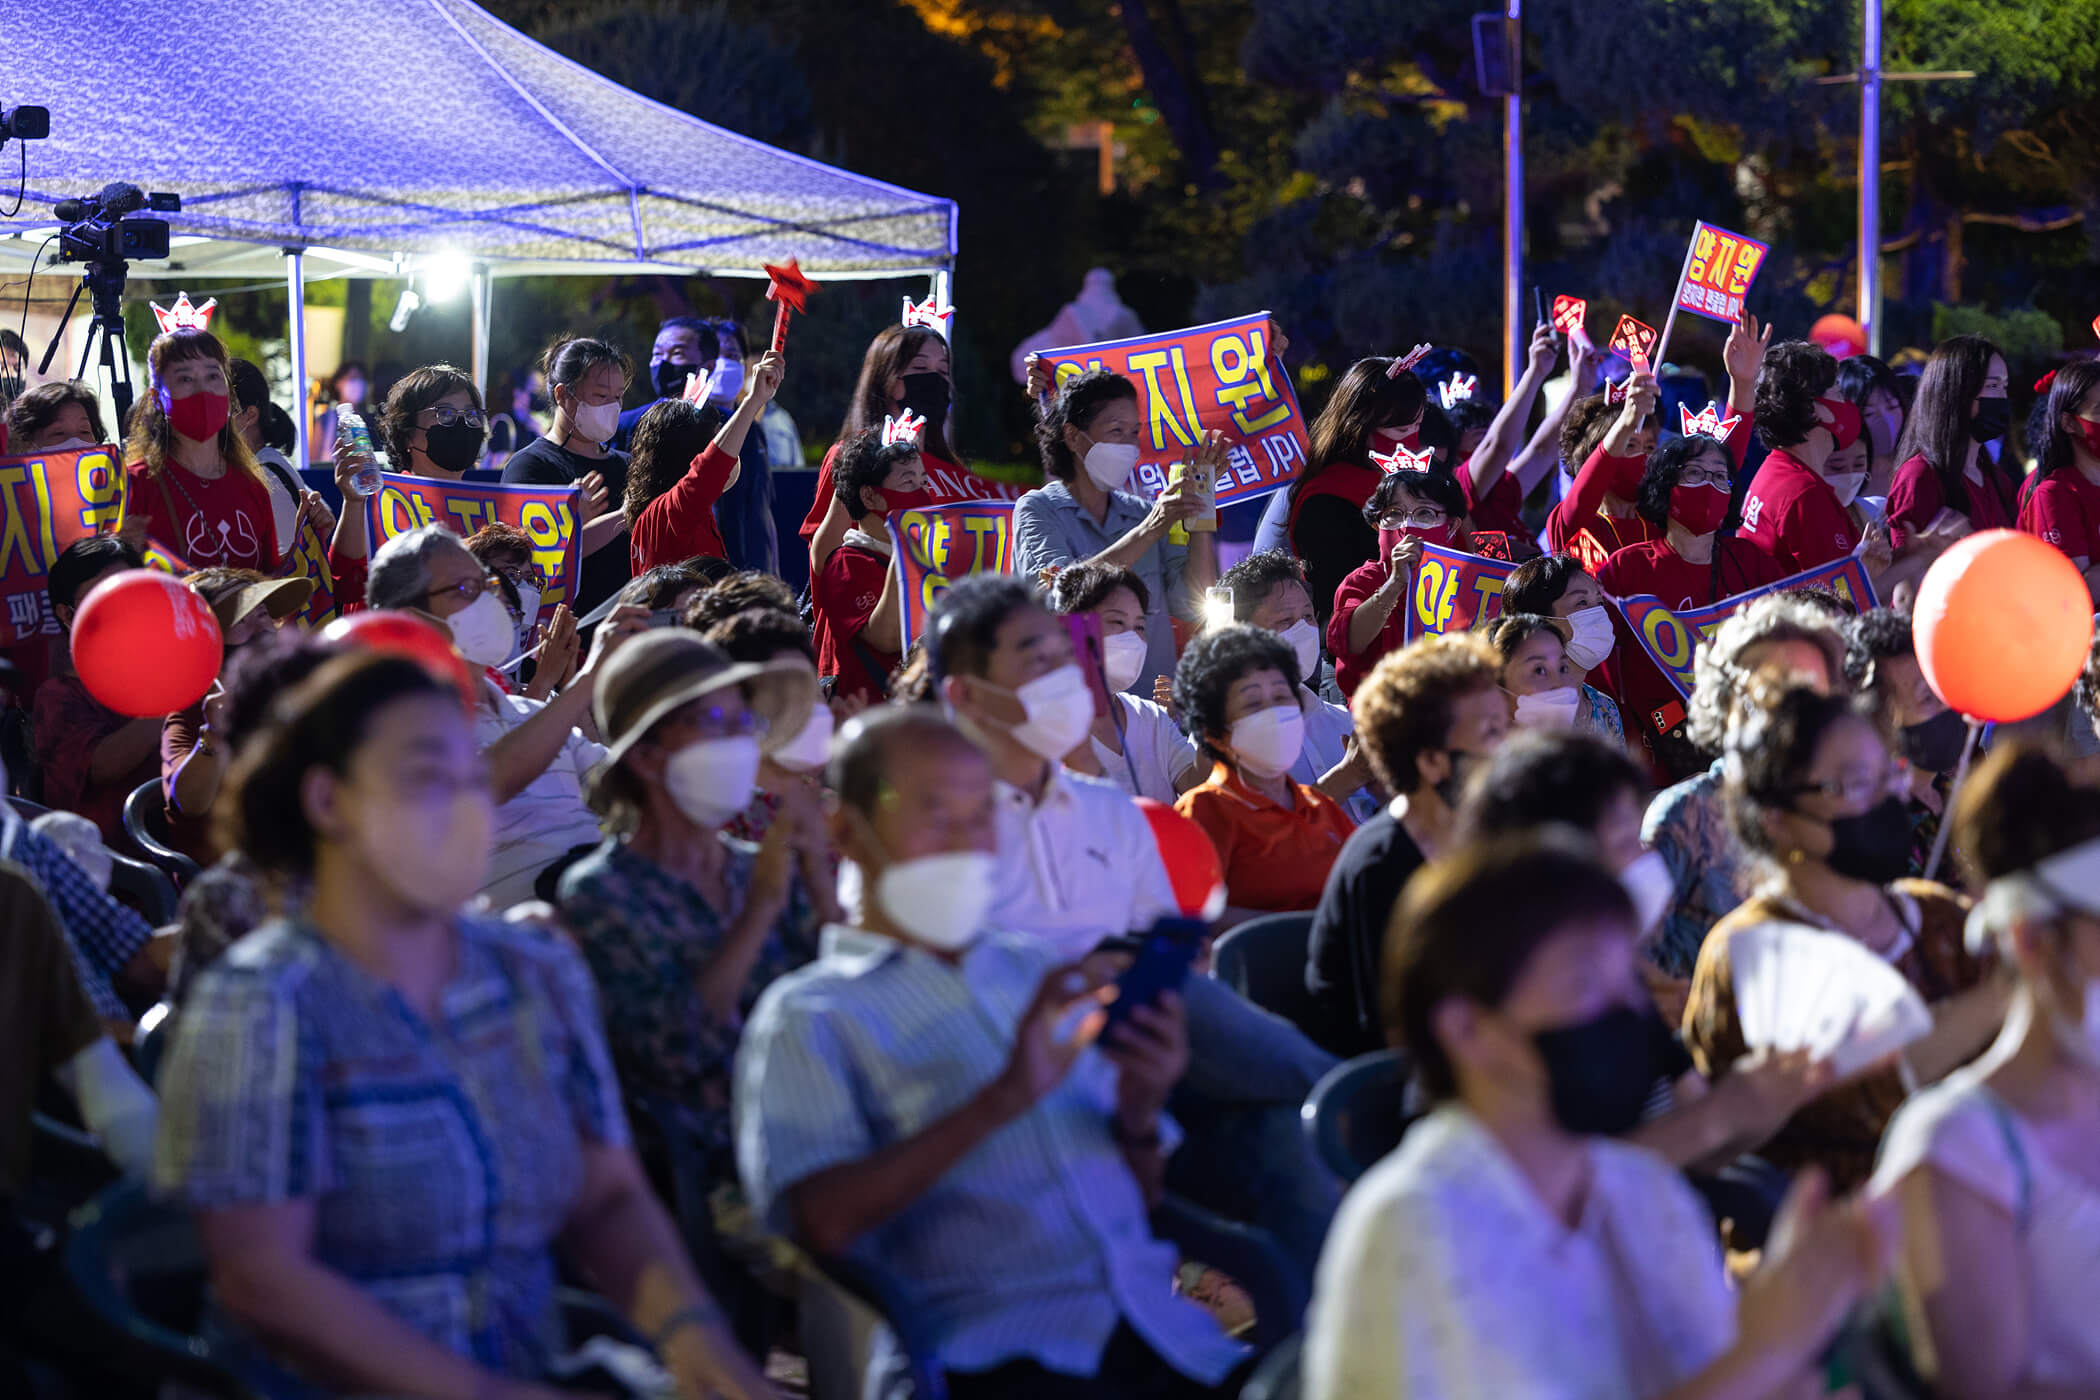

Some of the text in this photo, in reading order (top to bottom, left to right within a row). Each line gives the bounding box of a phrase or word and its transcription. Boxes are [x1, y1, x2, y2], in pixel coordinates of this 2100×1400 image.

[1687, 228, 1763, 294] 양지원
[1054, 329, 1293, 450] 지원
[926, 468, 991, 499] ANG
